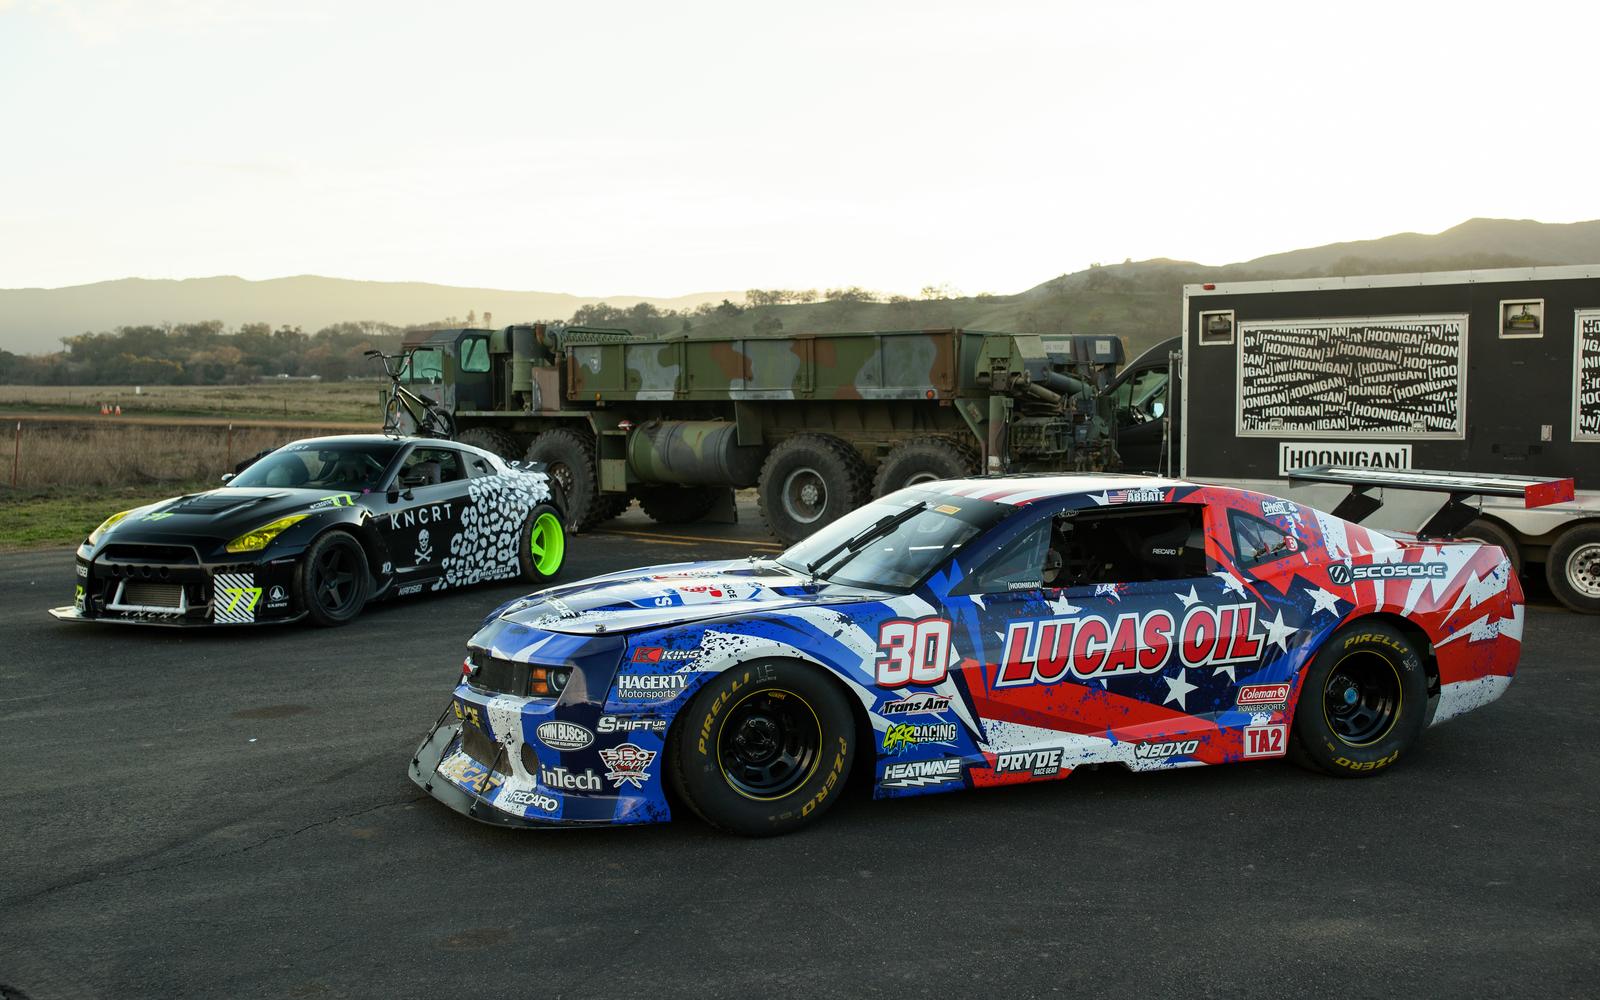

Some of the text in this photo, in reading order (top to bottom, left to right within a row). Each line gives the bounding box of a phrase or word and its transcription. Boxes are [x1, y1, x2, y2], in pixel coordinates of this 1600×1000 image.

[1262, 340, 1325, 363] [HOONIGAN]
[1335, 341, 1402, 364] [HOONIGAN]
[1261, 403, 1324, 418] [HOONIGAN]
[1351, 402, 1419, 424] [HOONIGAN]
[1284, 446, 1407, 472] [HOONIGAN]
[1127, 491, 1165, 502] ABBATE
[390, 503, 452, 530] KNCRT
[479, 565, 512, 579] MICHELIN
[1353, 565, 1444, 579] SCOSCHE
[224, 587, 262, 613] 77
[877, 618, 951, 688] 30
[999, 605, 1264, 684] LUCAS OIL
[1344, 633, 1408, 654] PIRELLI
[618, 689, 676, 699] Motorsports
[1242, 688, 1276, 700] Coleman
[699, 672, 750, 756] PIRELLI
[884, 701, 922, 714] Trans
[922, 697, 949, 711] Am
[1238, 704, 1286, 712] POWERSPORTS
[540, 724, 588, 742] TWIN BUSCH
[597, 717, 652, 732] SHIFT
[914, 724, 957, 742] RACING
[1147, 740, 1199, 757] BOXO
[1248, 728, 1283, 753] TA2
[606, 750, 649, 760] 5150
[996, 750, 1062, 772] PRYDE
[541, 764, 601, 790] inTech
[884, 758, 961, 780] HEATWAVE
[511, 791, 558, 812] RECARO
